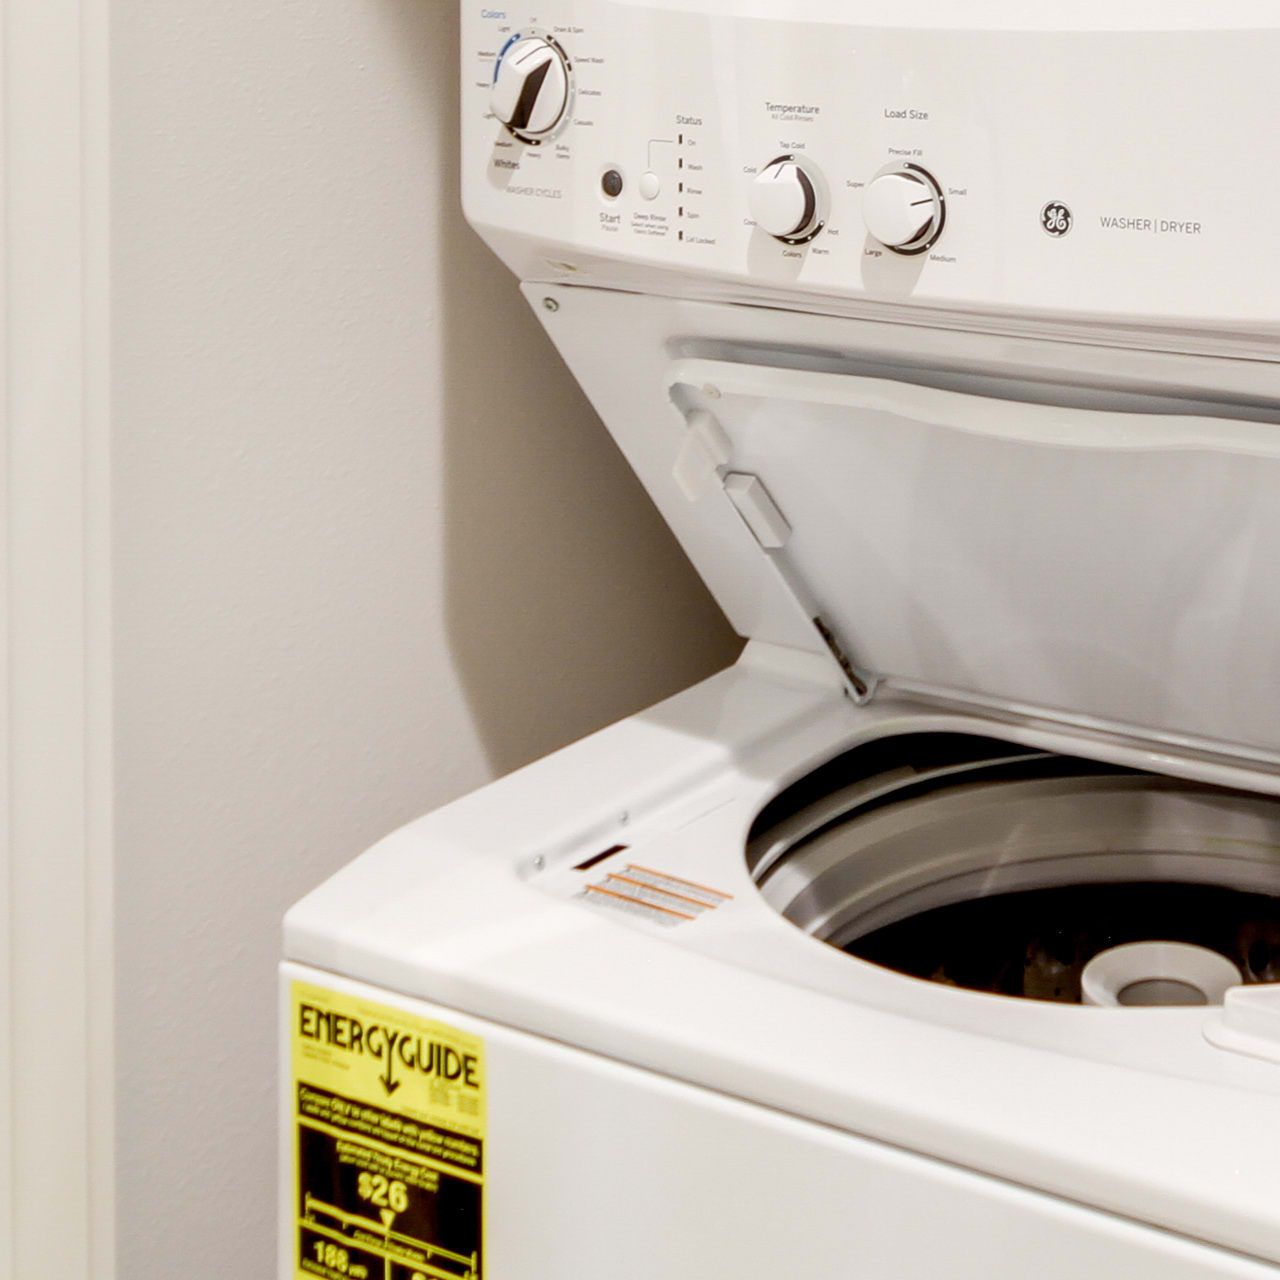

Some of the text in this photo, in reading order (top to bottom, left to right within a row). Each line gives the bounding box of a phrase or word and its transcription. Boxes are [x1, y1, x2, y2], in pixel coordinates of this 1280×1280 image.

[481, 9, 506, 19] Colors
[765, 102, 820, 114] Temperature
[884, 109, 928, 120] Load Size
[676, 115, 702, 126] Status
[780, 141, 790, 149] Tap
[888, 148, 911, 156] Precise
[494, 159, 520, 170] Whites
[846, 180, 864, 188] Super
[536, 188, 562, 199] CYCLES
[599, 213, 621, 224] Start
[1100, 216, 1201, 235] WASHER DRYER
[782, 250, 802, 258] Colors
[864, 248, 882, 257] Large
[930, 254, 956, 263] Medium
[299, 1002, 480, 1089] ENERGYGUIDE
[358, 1171, 408, 1213] $26
